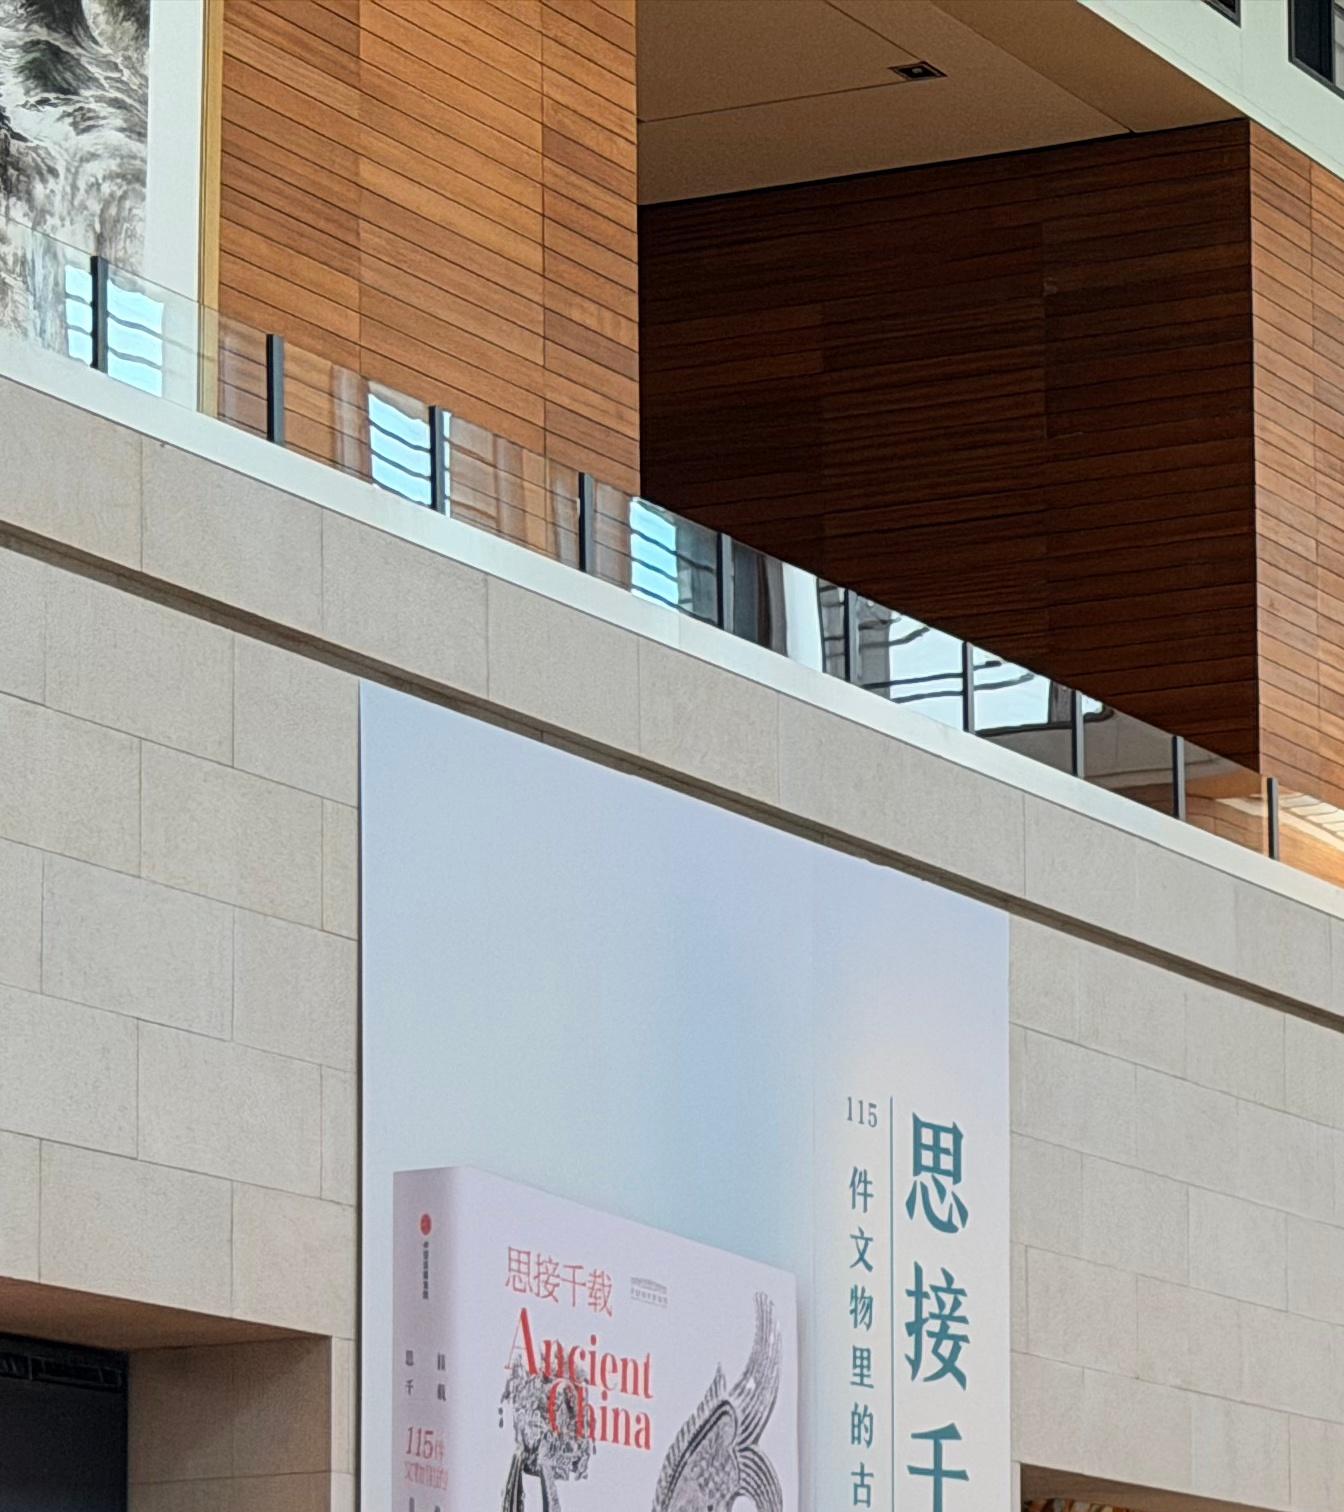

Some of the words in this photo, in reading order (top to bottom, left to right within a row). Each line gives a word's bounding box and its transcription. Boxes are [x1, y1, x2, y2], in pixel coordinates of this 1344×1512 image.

[505, 1247, 613, 1317] 思接千载
[504, 1307, 654, 1400] Ancient
[548, 1379, 652, 1451] China
